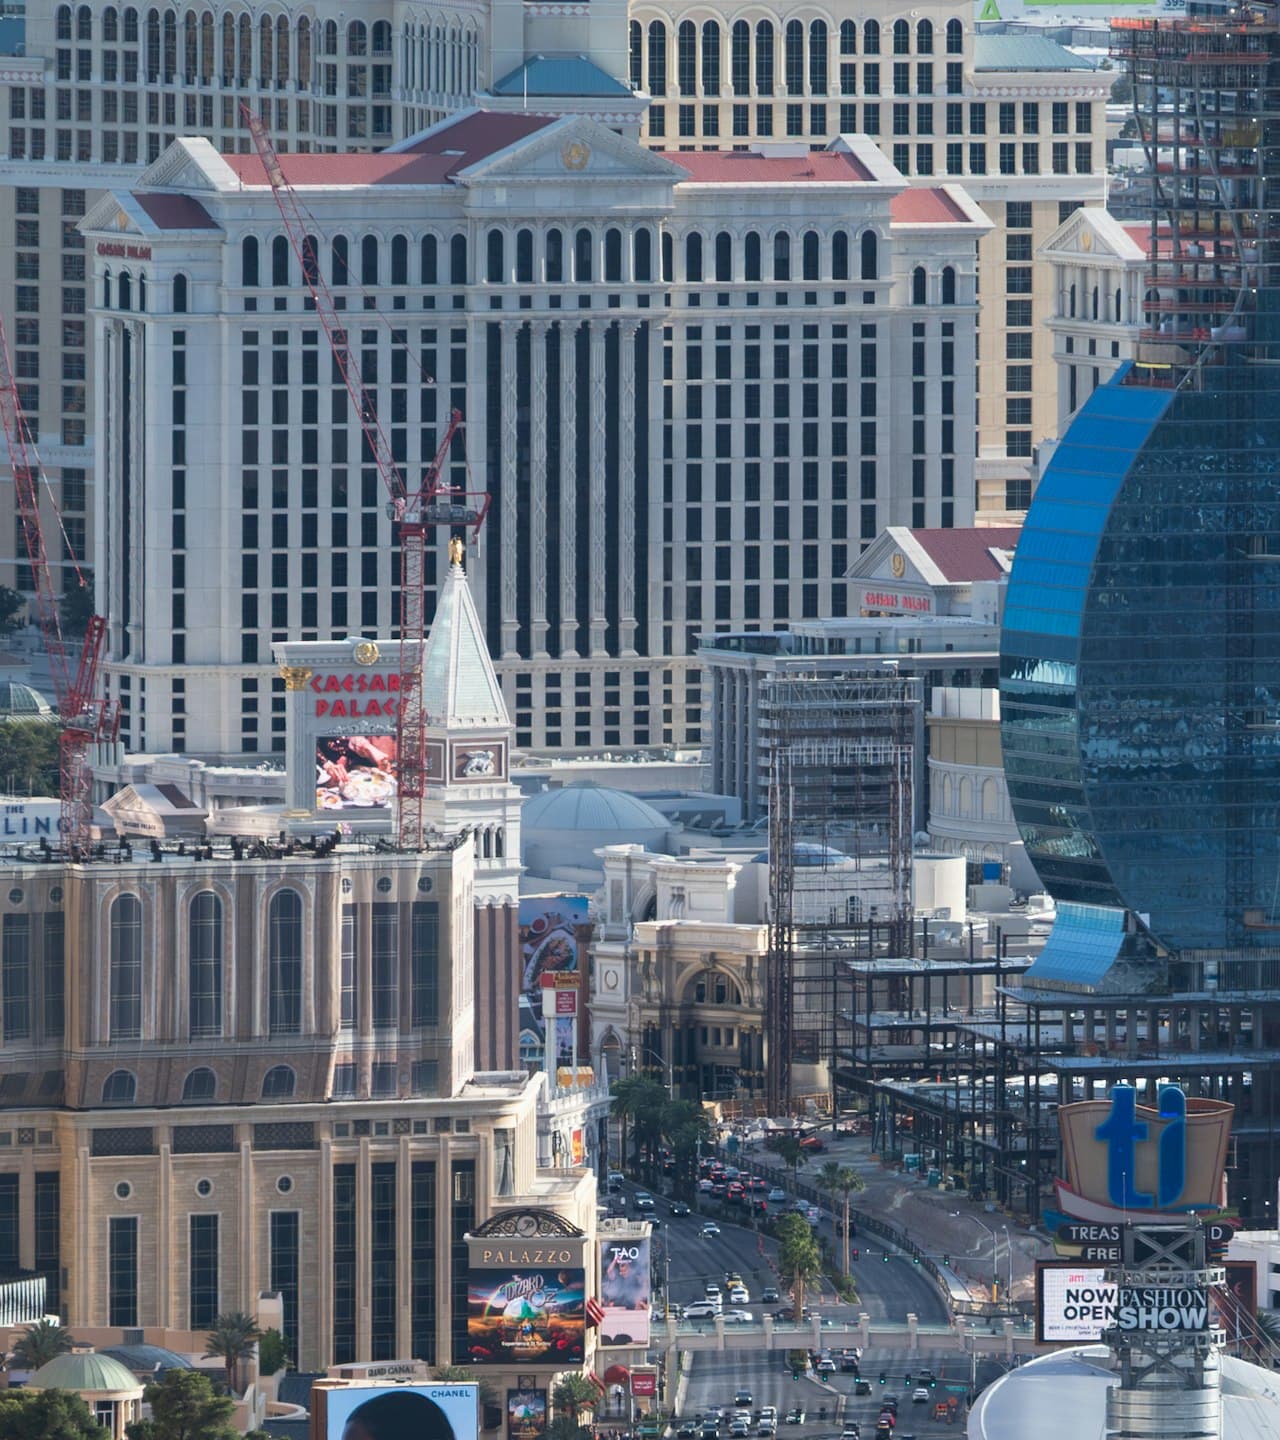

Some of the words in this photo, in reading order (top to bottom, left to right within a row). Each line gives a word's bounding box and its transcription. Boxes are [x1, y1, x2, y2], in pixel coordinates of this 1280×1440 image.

[5, 806, 25, 814] THE
[483, 1250, 571, 1263] PALAZZO
[611, 1247, 640, 1259] TAO
[1066, 1288, 1115, 1305] NOW
[1119, 1288, 1207, 1308] FASHION
[1064, 1306, 1117, 1321] OPEN
[1120, 1308, 1207, 1329] SHOW
[388, 1364, 416, 1374] CANAL
[431, 1390, 470, 1398] CHANEL
